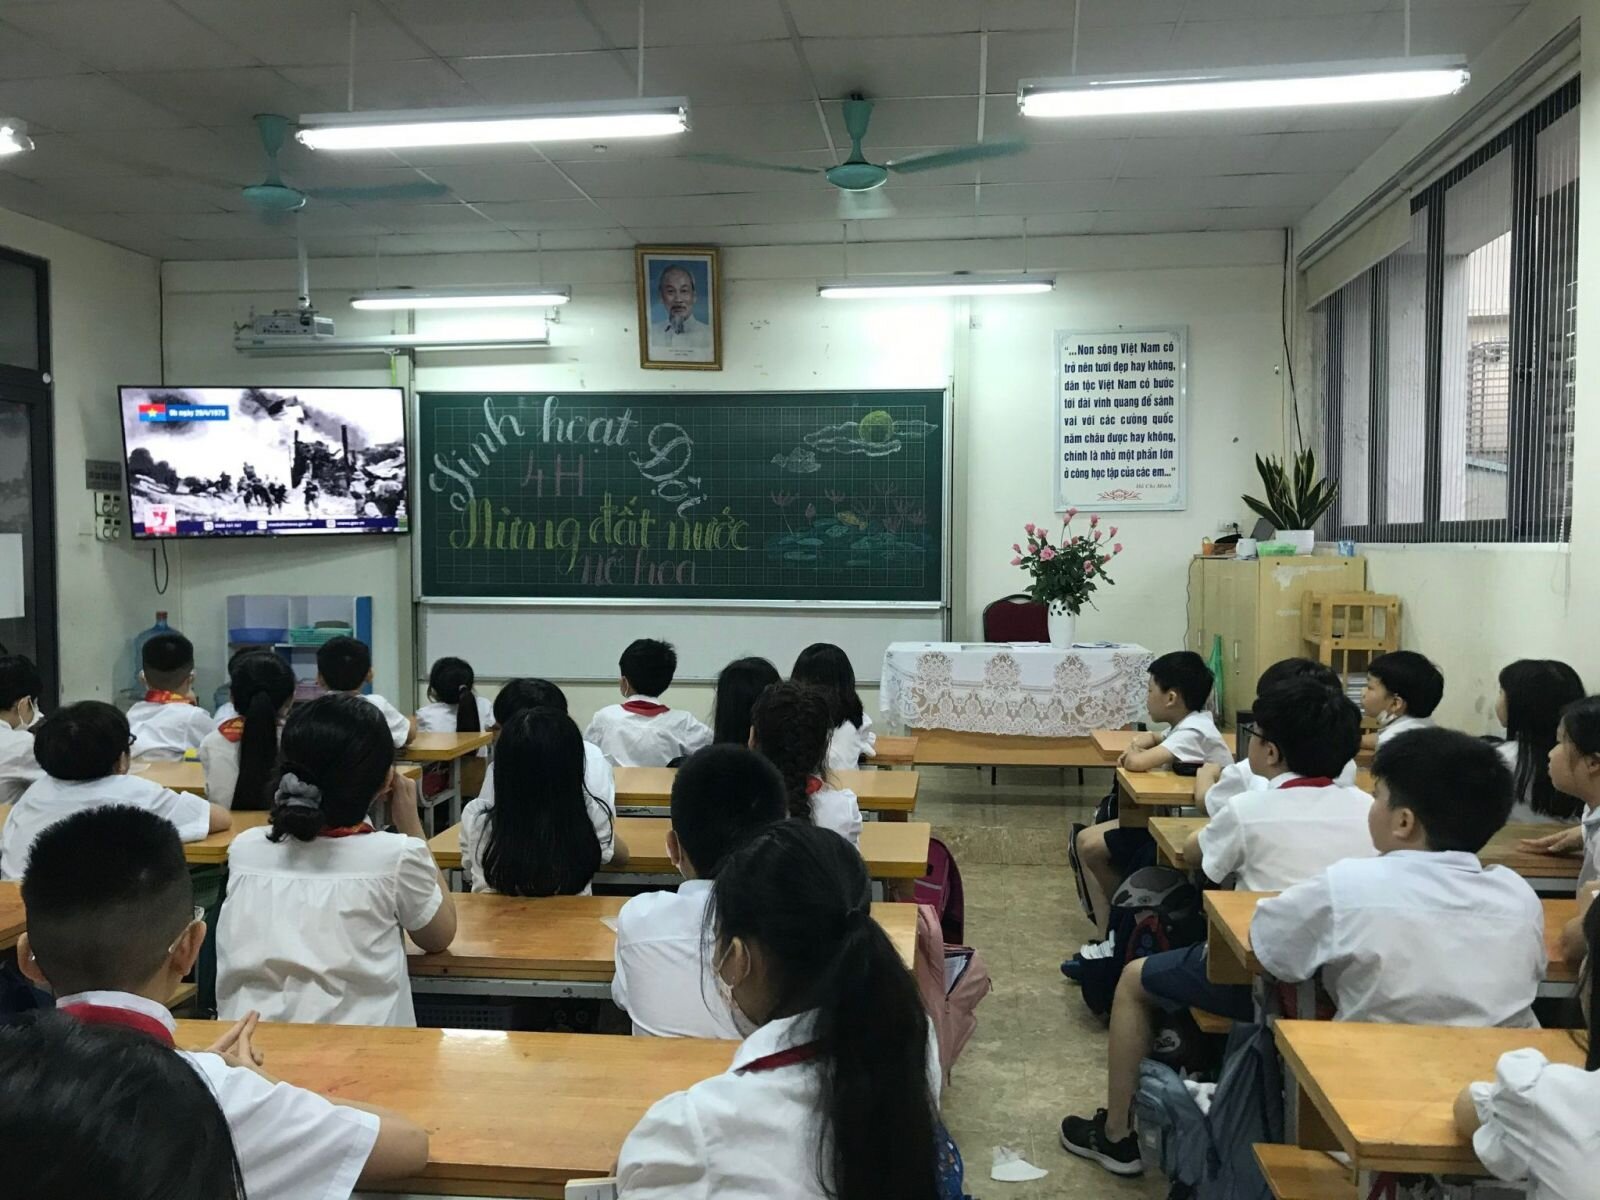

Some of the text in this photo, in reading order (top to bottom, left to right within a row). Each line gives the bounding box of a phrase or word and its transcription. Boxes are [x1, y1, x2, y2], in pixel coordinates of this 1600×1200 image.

[1098, 344, 1117, 355] sông
[1121, 343, 1137, 356] Việt
[1141, 342, 1160, 352] Nam
[1163, 342, 1174, 352] có
[1065, 360, 1175, 374] trở nên tươi đẹp hay không,
[1065, 377, 1174, 392] dân tộc Việt Nam có bước
[1064, 397, 1074, 408] tới
[1094, 397, 1111, 407] vinh
[1114, 398, 1139, 408] quang
[1141, 394, 1152, 406] để
[1154, 395, 1174, 406] sánh
[1064, 412, 1173, 425] vai với các cường quốc
[1064, 431, 1175, 445] năm châu được hay không,
[429, 395, 707, 519] Sinh hoạt Đội
[1064, 447, 1173, 462] chính là nhờ một phần lớn
[1071, 468, 1089, 479] công
[1092, 468, 1105, 480] học
[1107, 467, 1119, 480] tập
[1121, 467, 1134, 477] của
[1136, 467, 1150, 477] các
[589, 491, 656, 548] đất
[667, 506, 749, 551] nước
[634, 547, 697, 586] hoa
